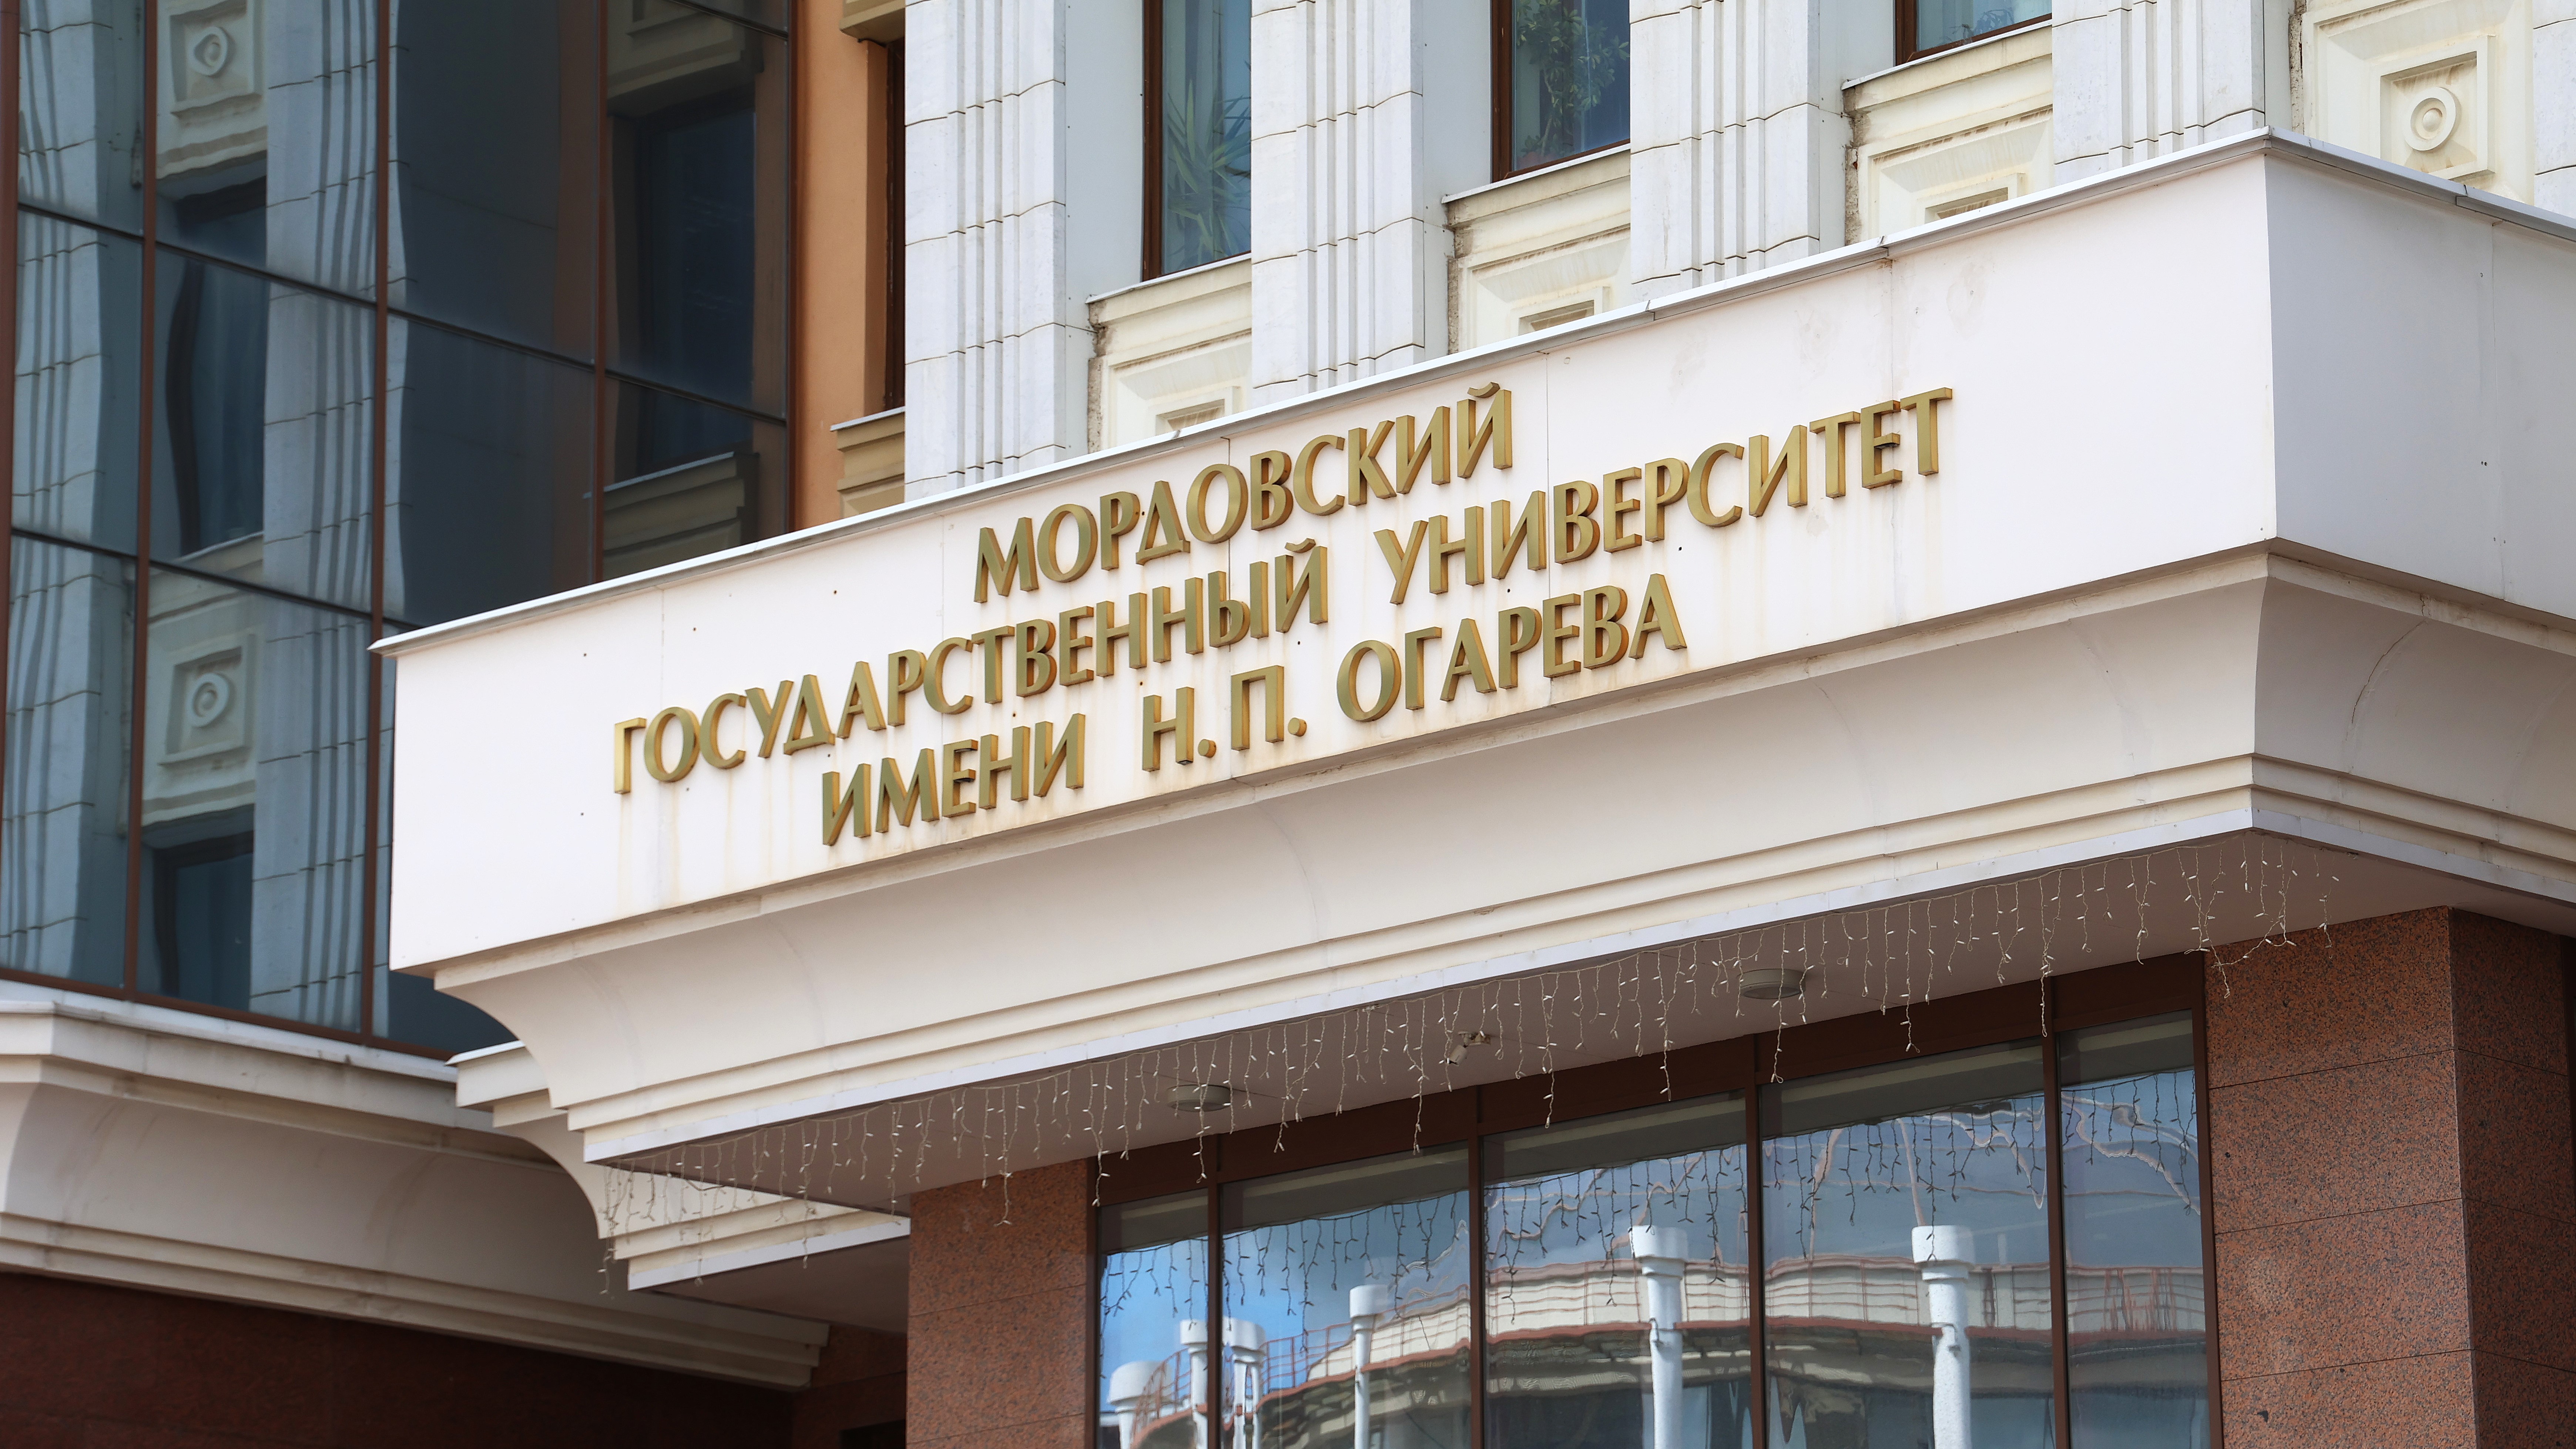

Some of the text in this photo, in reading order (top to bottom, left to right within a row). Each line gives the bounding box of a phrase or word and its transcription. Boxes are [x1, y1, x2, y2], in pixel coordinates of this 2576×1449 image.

[616, 387, 1953, 796] ГОСУДАРСТВЕННЫЙ УНИВЕРСИТЕТ
[974, 382, 1513, 604] МОРДОВСКИЙ
[822, 573, 1687, 847] ИМЕНИ Н. П. ОГАРЕВА
